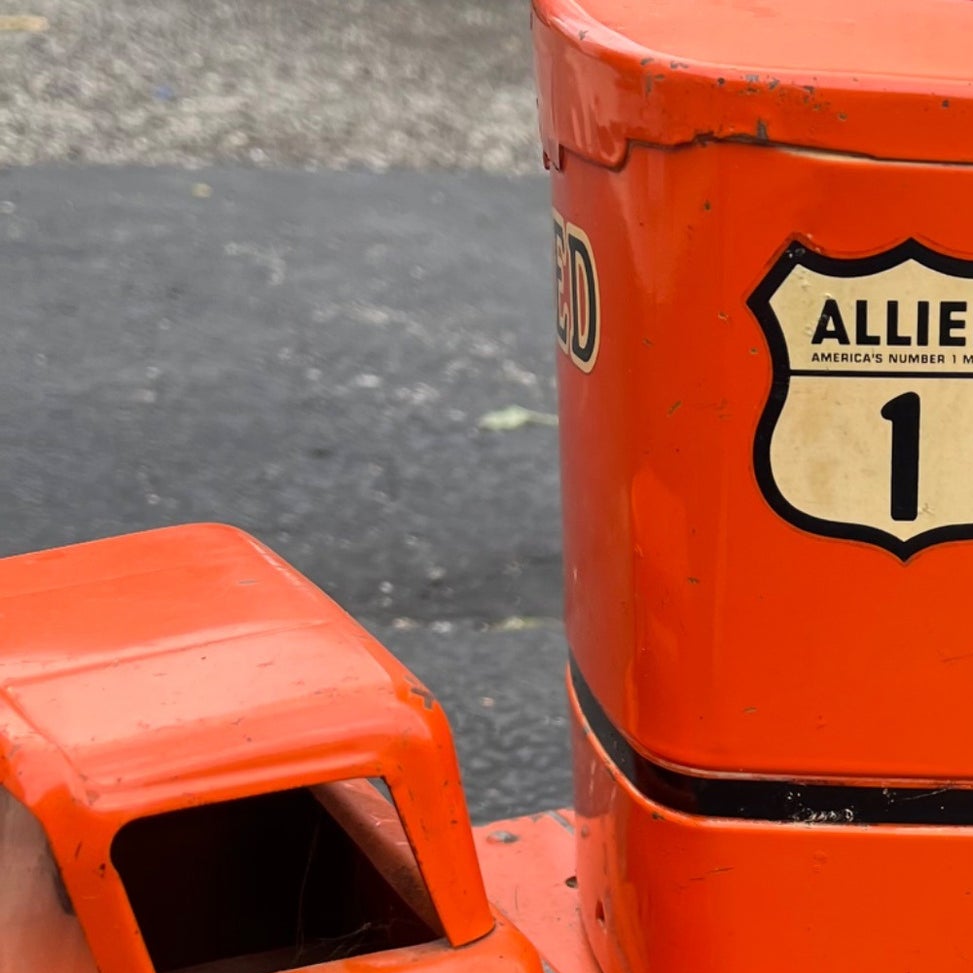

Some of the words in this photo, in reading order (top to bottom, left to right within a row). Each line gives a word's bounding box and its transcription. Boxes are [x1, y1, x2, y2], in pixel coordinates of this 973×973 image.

[811, 351, 883, 364] AMERICA'S
[888, 353, 945, 364] NUMBER
[952, 354, 957, 365] 1
[880, 391, 921, 522] 1
